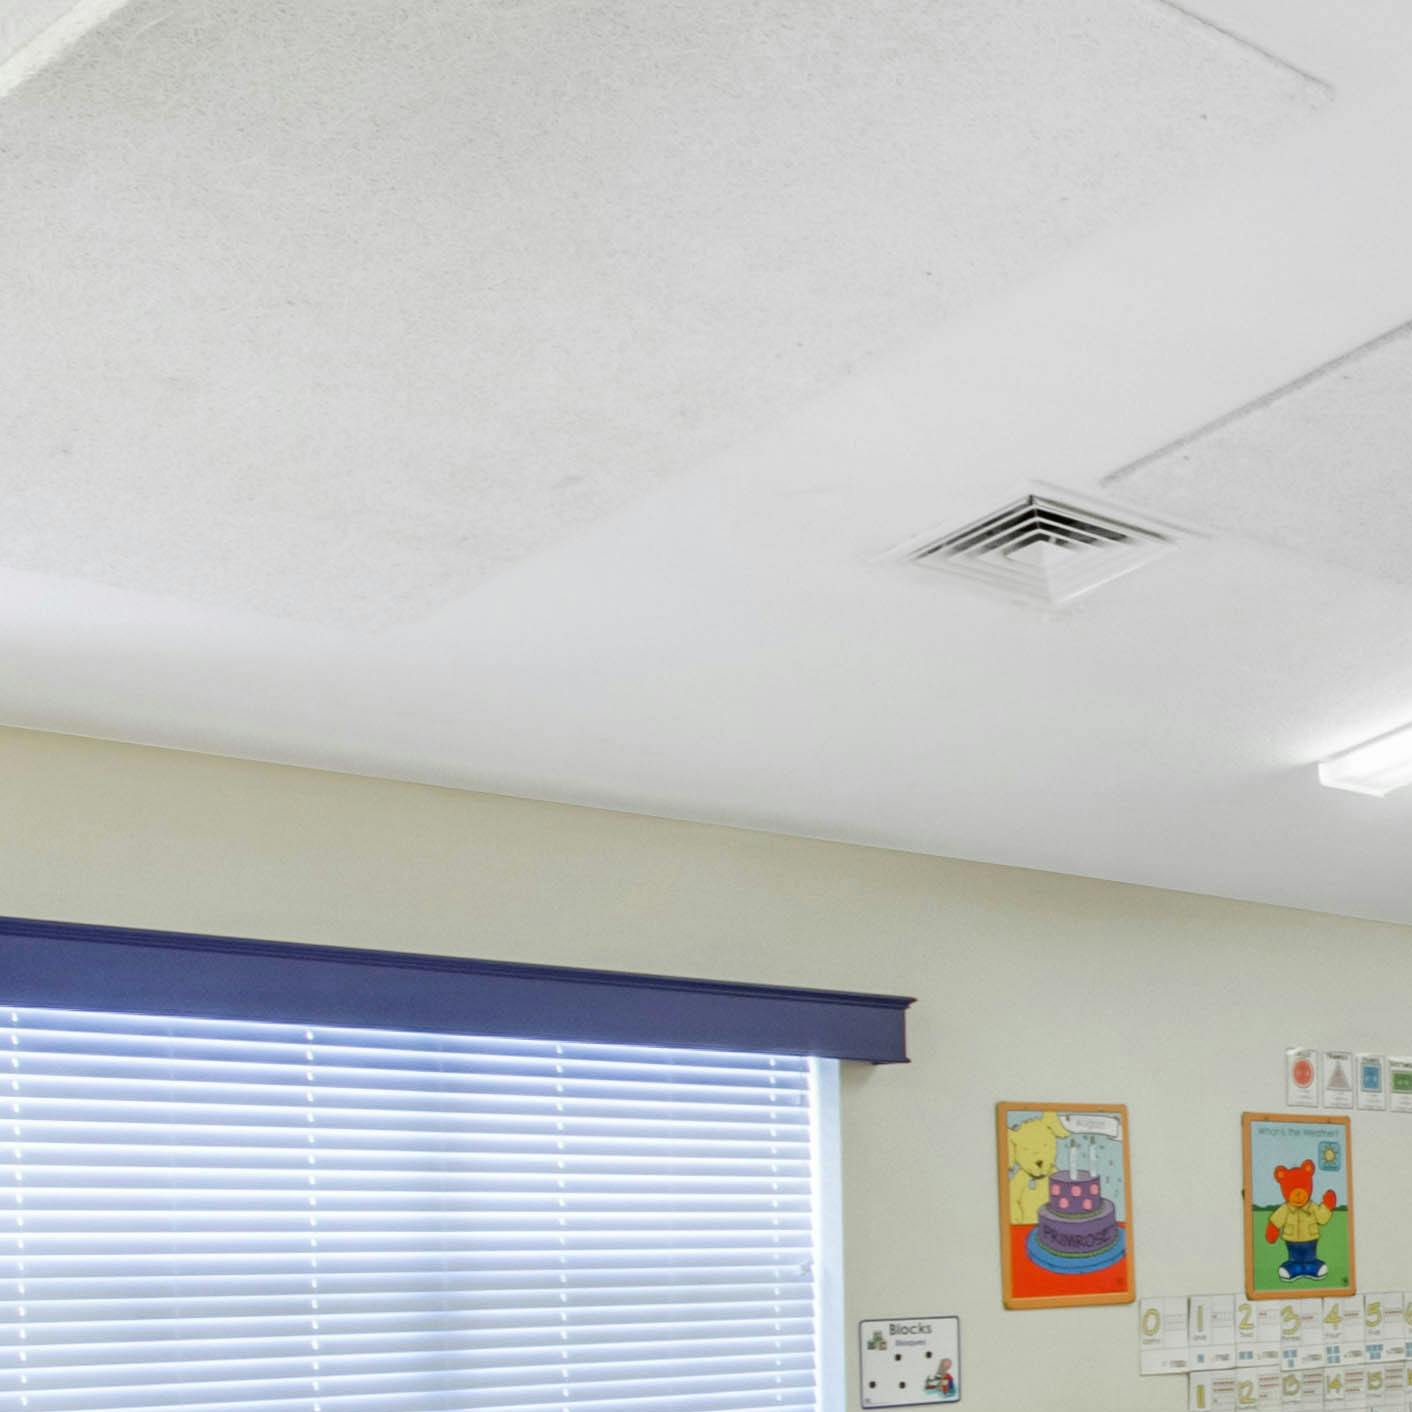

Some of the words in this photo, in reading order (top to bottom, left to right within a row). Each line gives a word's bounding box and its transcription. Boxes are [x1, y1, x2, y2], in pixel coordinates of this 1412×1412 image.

[888, 1323, 932, 1336] Blocks
[1141, 1308, 1161, 1337] 0
[1196, 1304, 1204, 1332] 1
[1238, 1303, 1255, 1330] 2
[1280, 1305, 1300, 1336] 3
[1322, 1303, 1343, 1330] 4
[1364, 1301, 1382, 1328] 5
